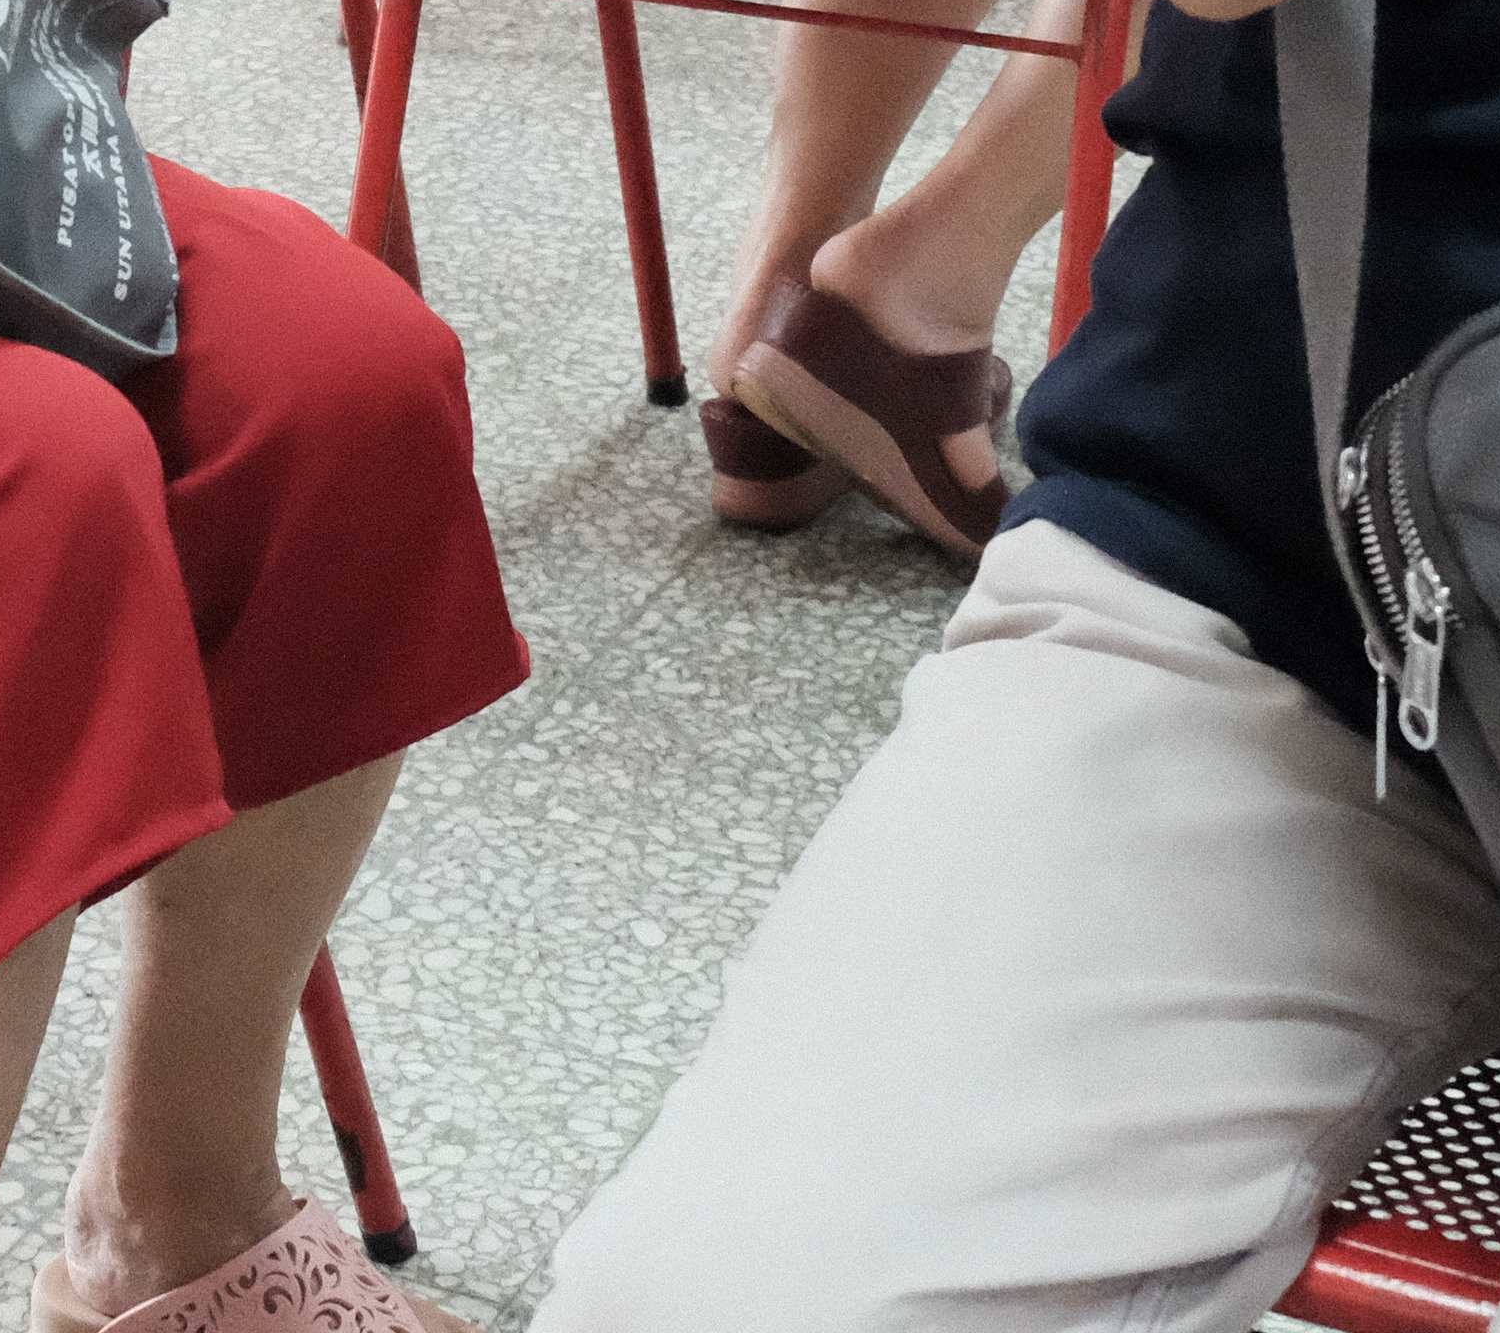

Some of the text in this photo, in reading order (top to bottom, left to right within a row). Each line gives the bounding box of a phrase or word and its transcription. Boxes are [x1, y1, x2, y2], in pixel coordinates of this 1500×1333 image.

[57, 146, 79, 249] PUSAT
[107, 133, 134, 302] SUN UTARA
